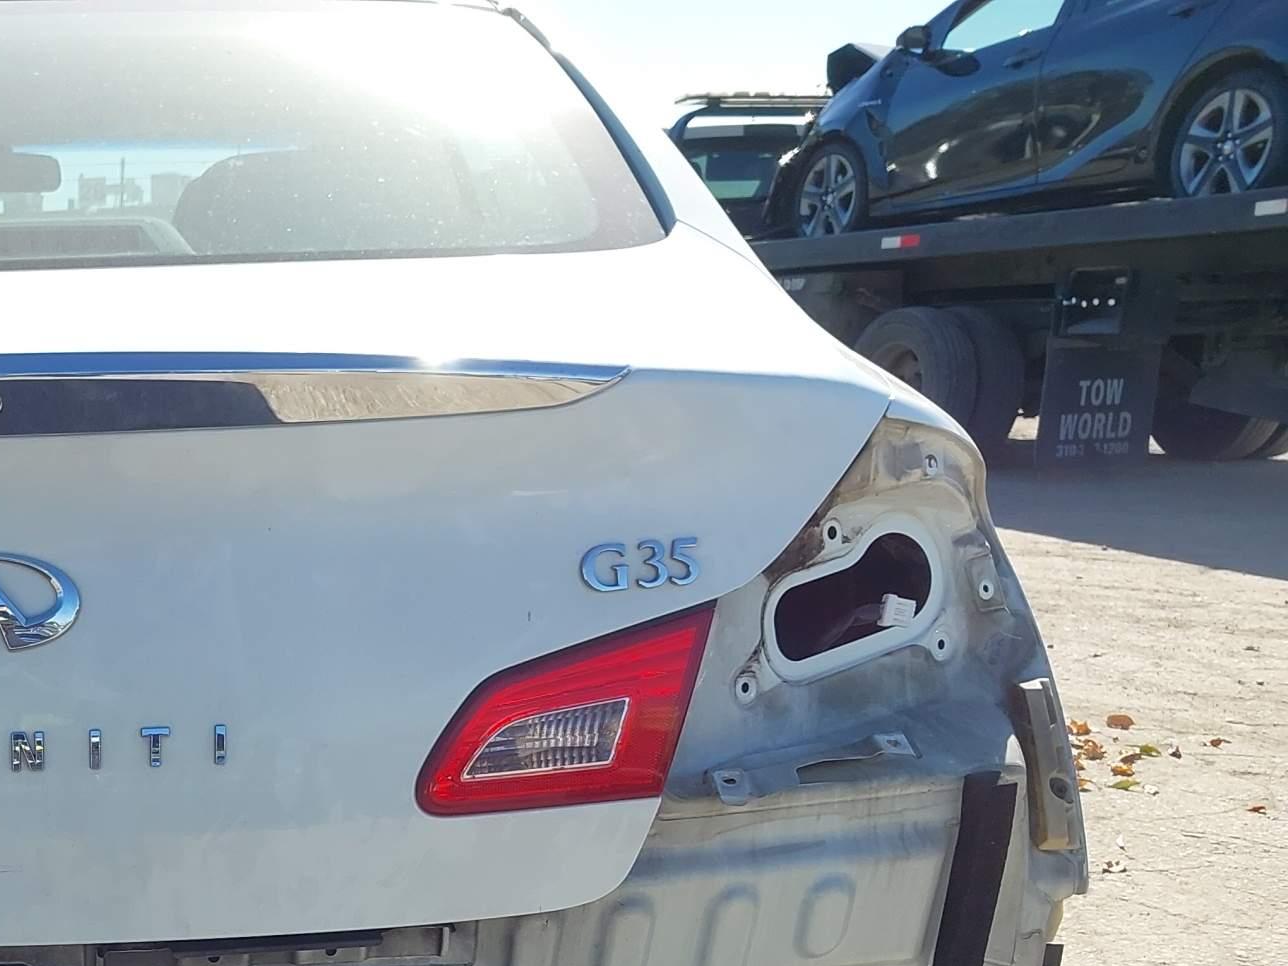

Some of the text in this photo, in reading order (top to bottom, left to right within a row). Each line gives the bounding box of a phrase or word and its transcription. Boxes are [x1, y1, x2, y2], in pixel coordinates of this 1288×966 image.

[1079, 378, 1125, 406] TOW
[1059, 411, 1133, 441] WORLD
[581, 537, 699, 592] G35
